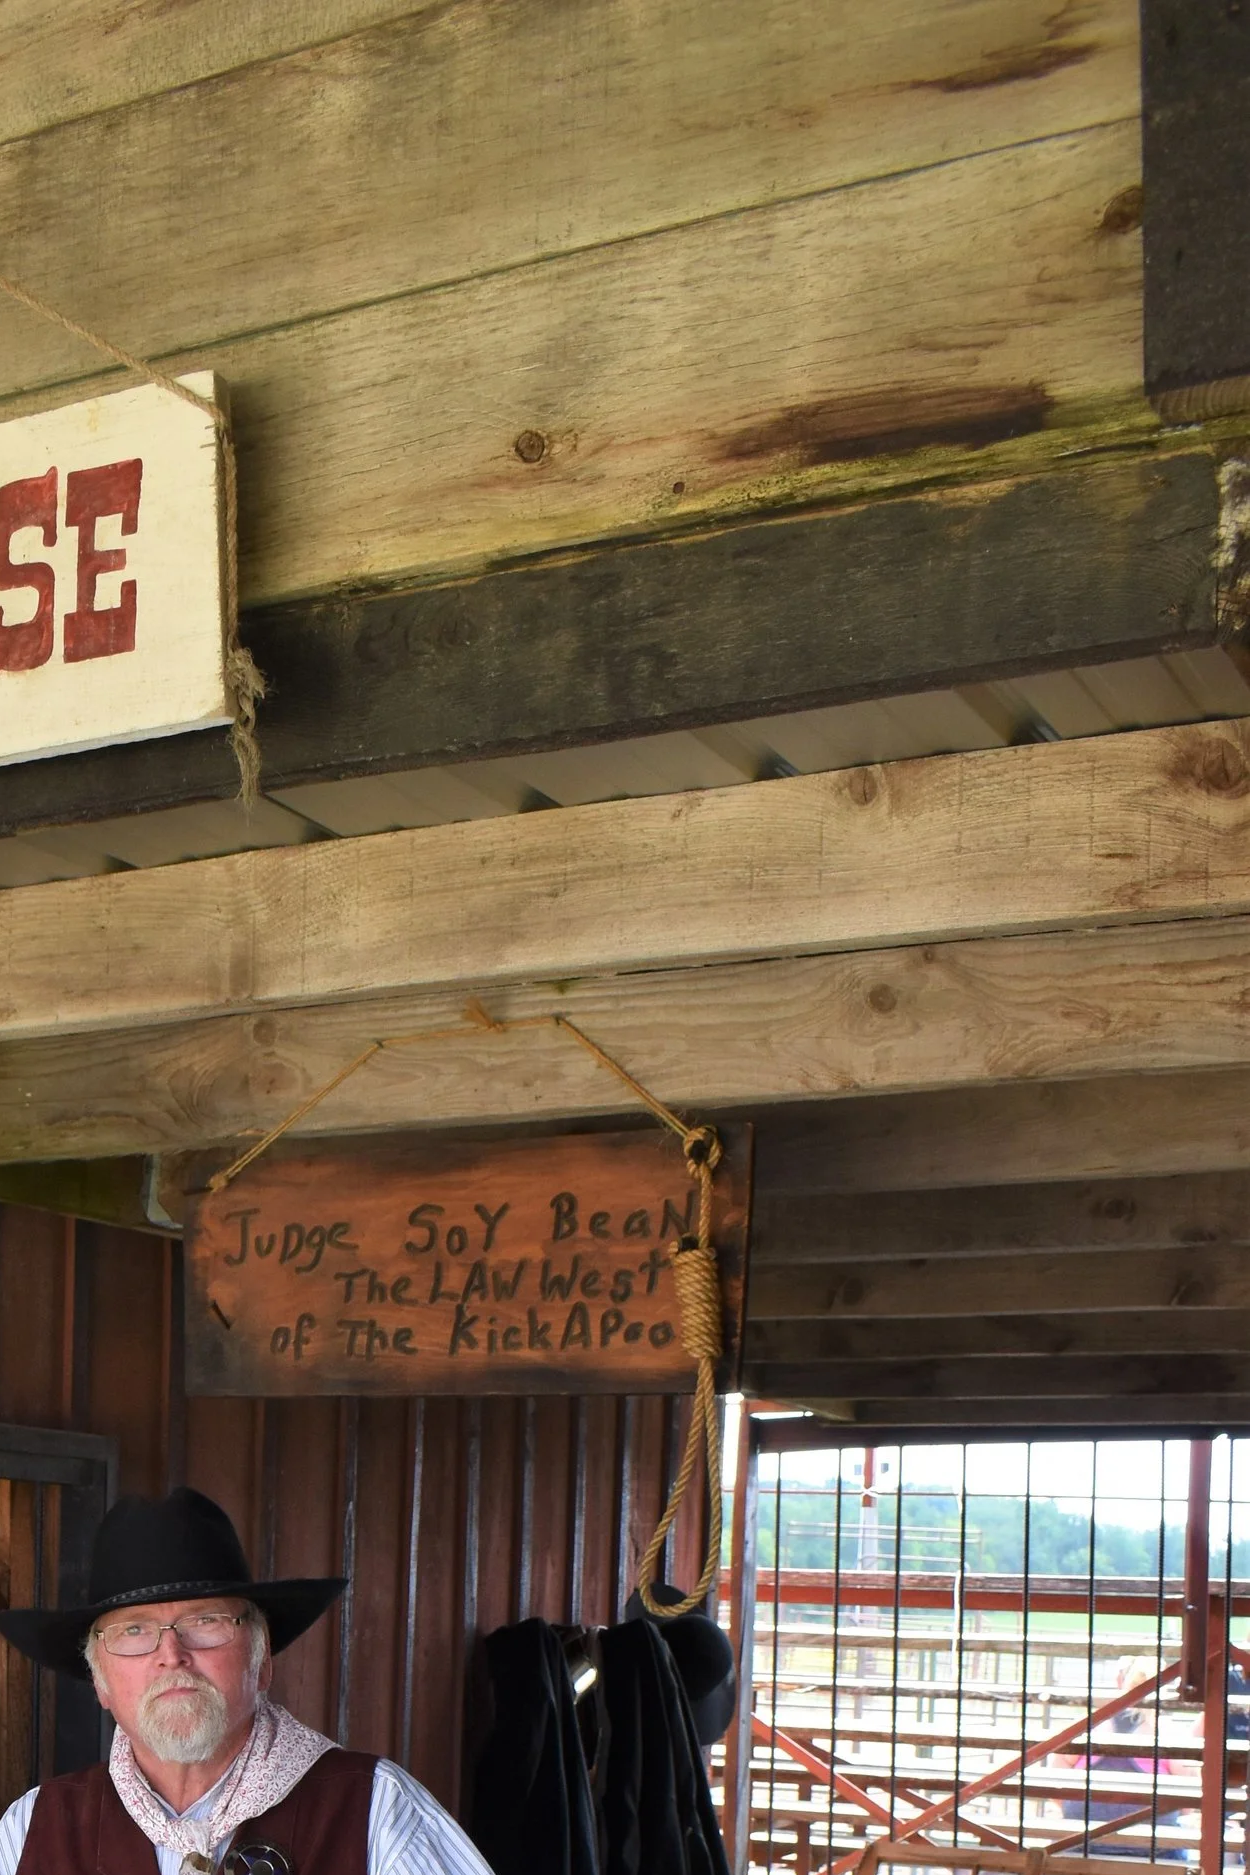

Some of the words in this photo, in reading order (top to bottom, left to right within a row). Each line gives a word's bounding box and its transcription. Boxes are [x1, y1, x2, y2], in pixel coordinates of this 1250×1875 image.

[334, 1268, 419, 1305] The
[429, 1257, 529, 1304] LAW
[540, 1248, 672, 1303] West
[269, 1313, 316, 1361] of
[337, 1319, 419, 1361] The
